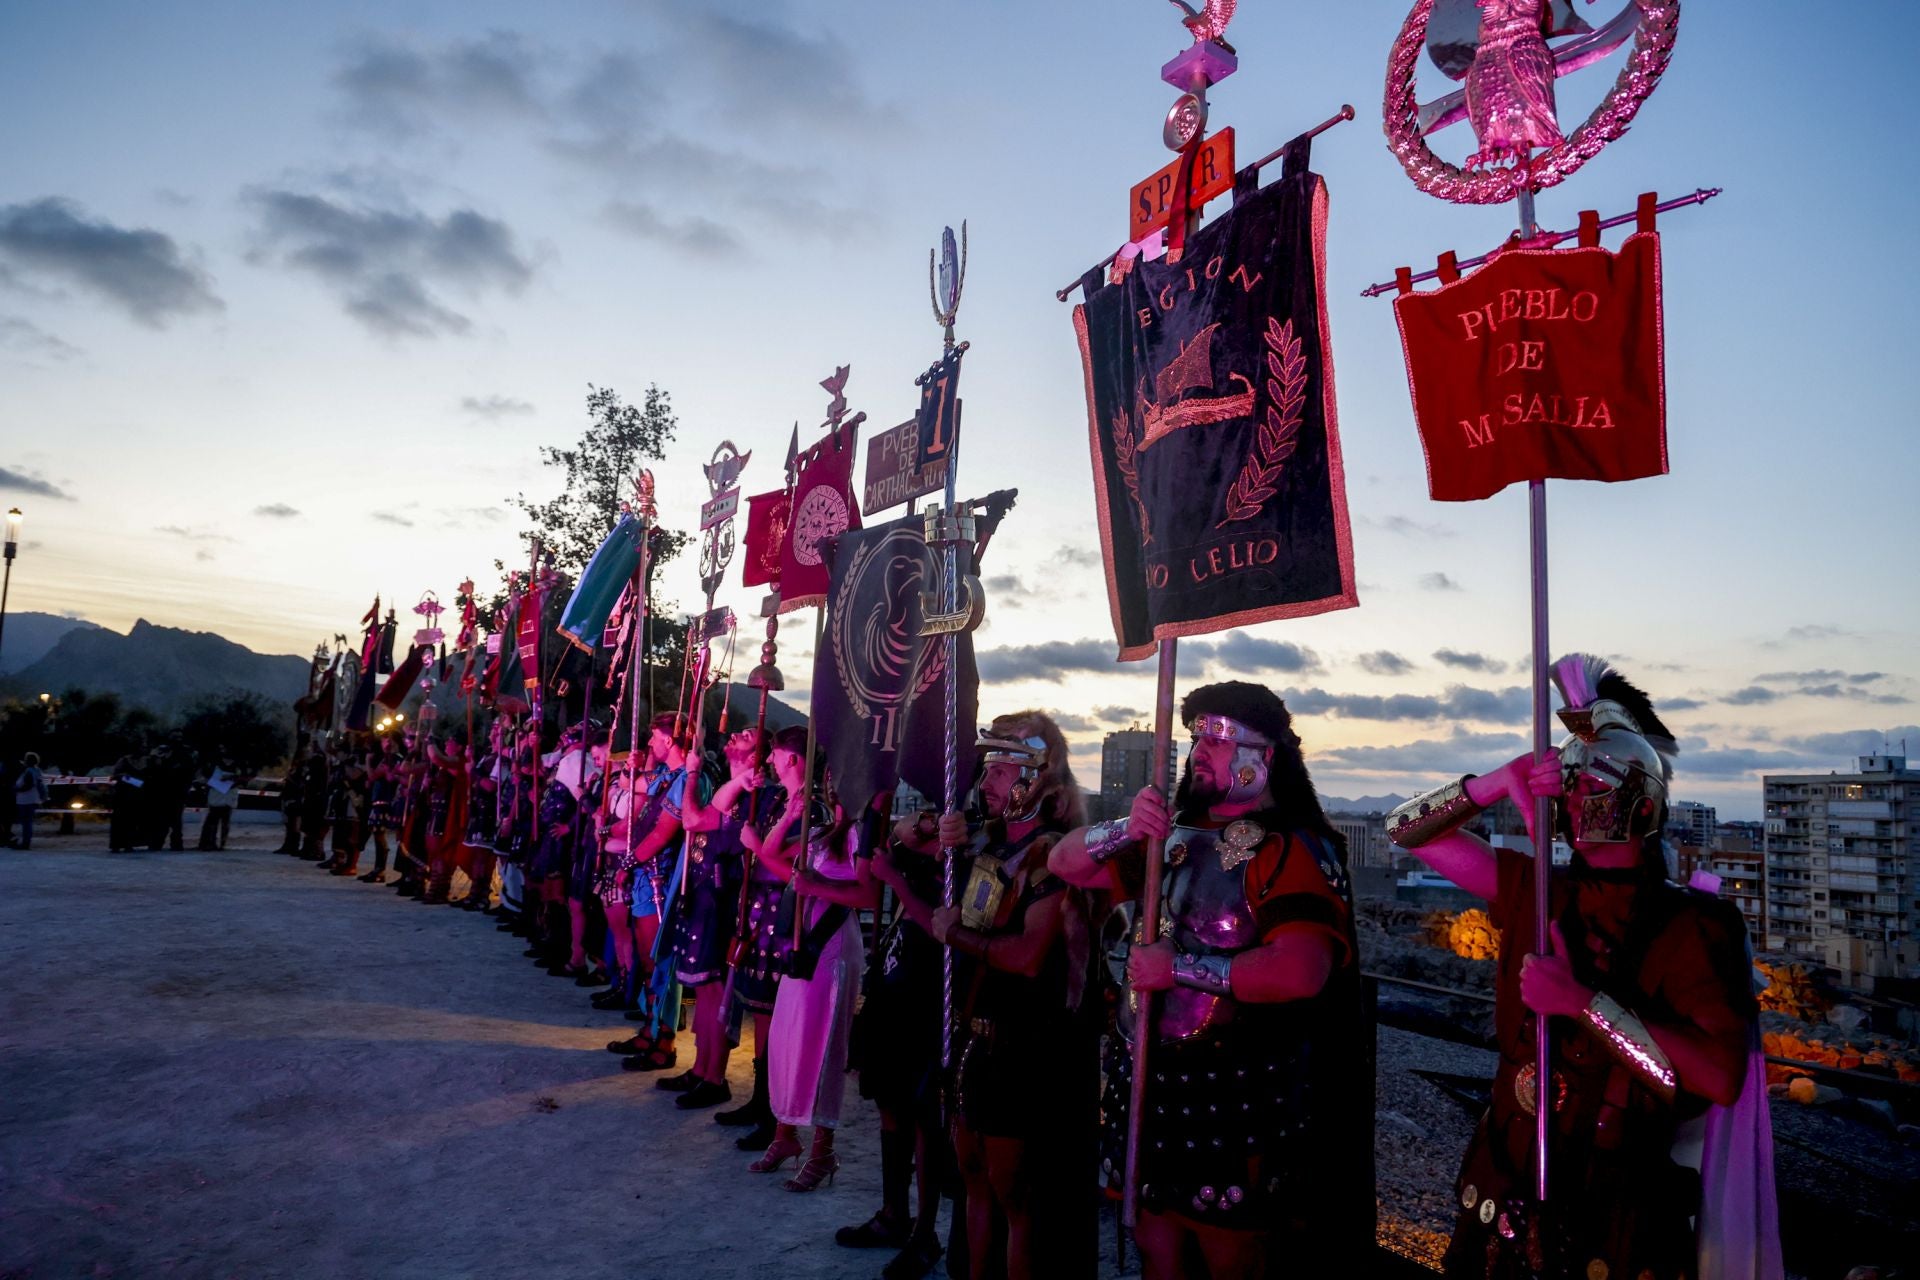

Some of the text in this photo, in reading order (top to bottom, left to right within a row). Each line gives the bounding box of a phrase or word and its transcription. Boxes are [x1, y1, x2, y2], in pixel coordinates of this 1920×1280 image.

[1138, 145, 1219, 224] SPR
[1137, 255, 1263, 329] EGION
[1496, 340, 1545, 377] DE
[882, 422, 919, 462] PVEB
[899, 449, 916, 473] DE
[1189, 539, 1278, 582] LELIO
